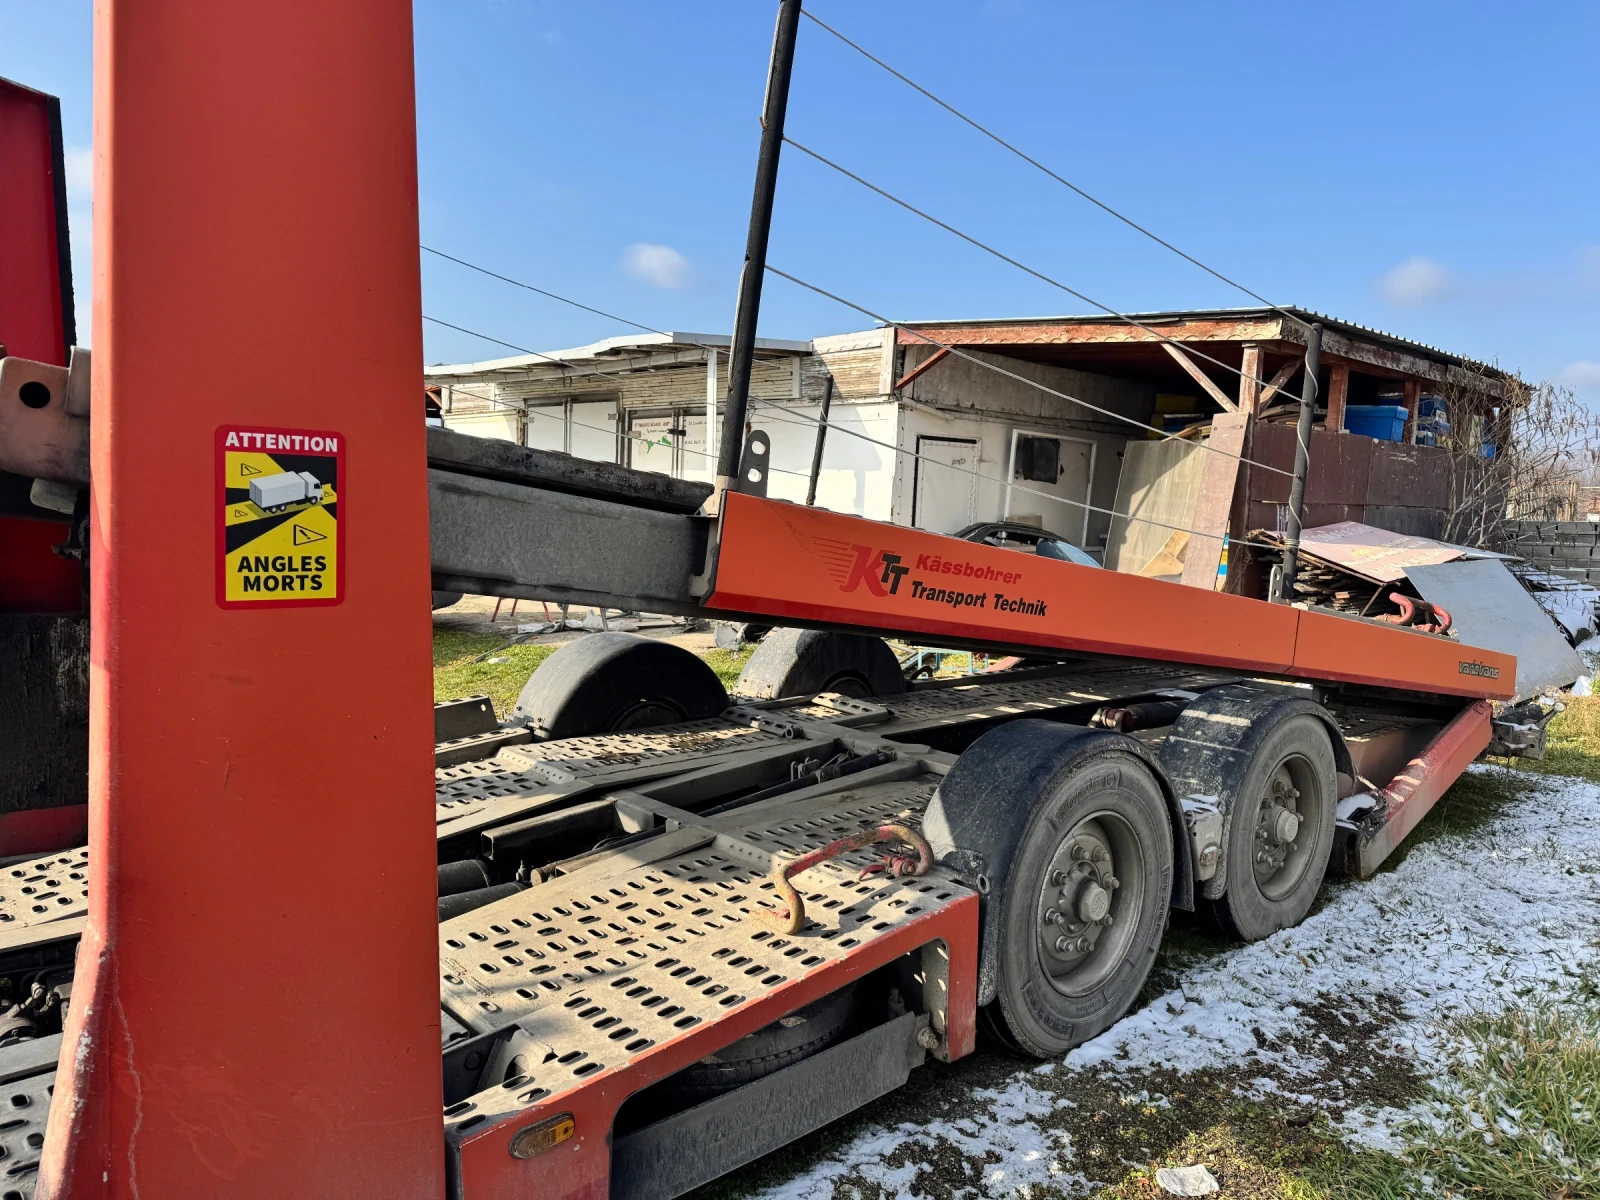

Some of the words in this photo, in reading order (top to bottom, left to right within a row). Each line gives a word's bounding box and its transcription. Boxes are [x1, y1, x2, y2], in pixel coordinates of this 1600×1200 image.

[225, 431, 338, 452] ATTENTION
[237, 555, 327, 573] ANGLES
[915, 553, 1022, 585] Kässbohrer
[243, 574, 323, 592] MORTS
[911, 580, 987, 608] Transport
[993, 593, 1048, 617] Technik
